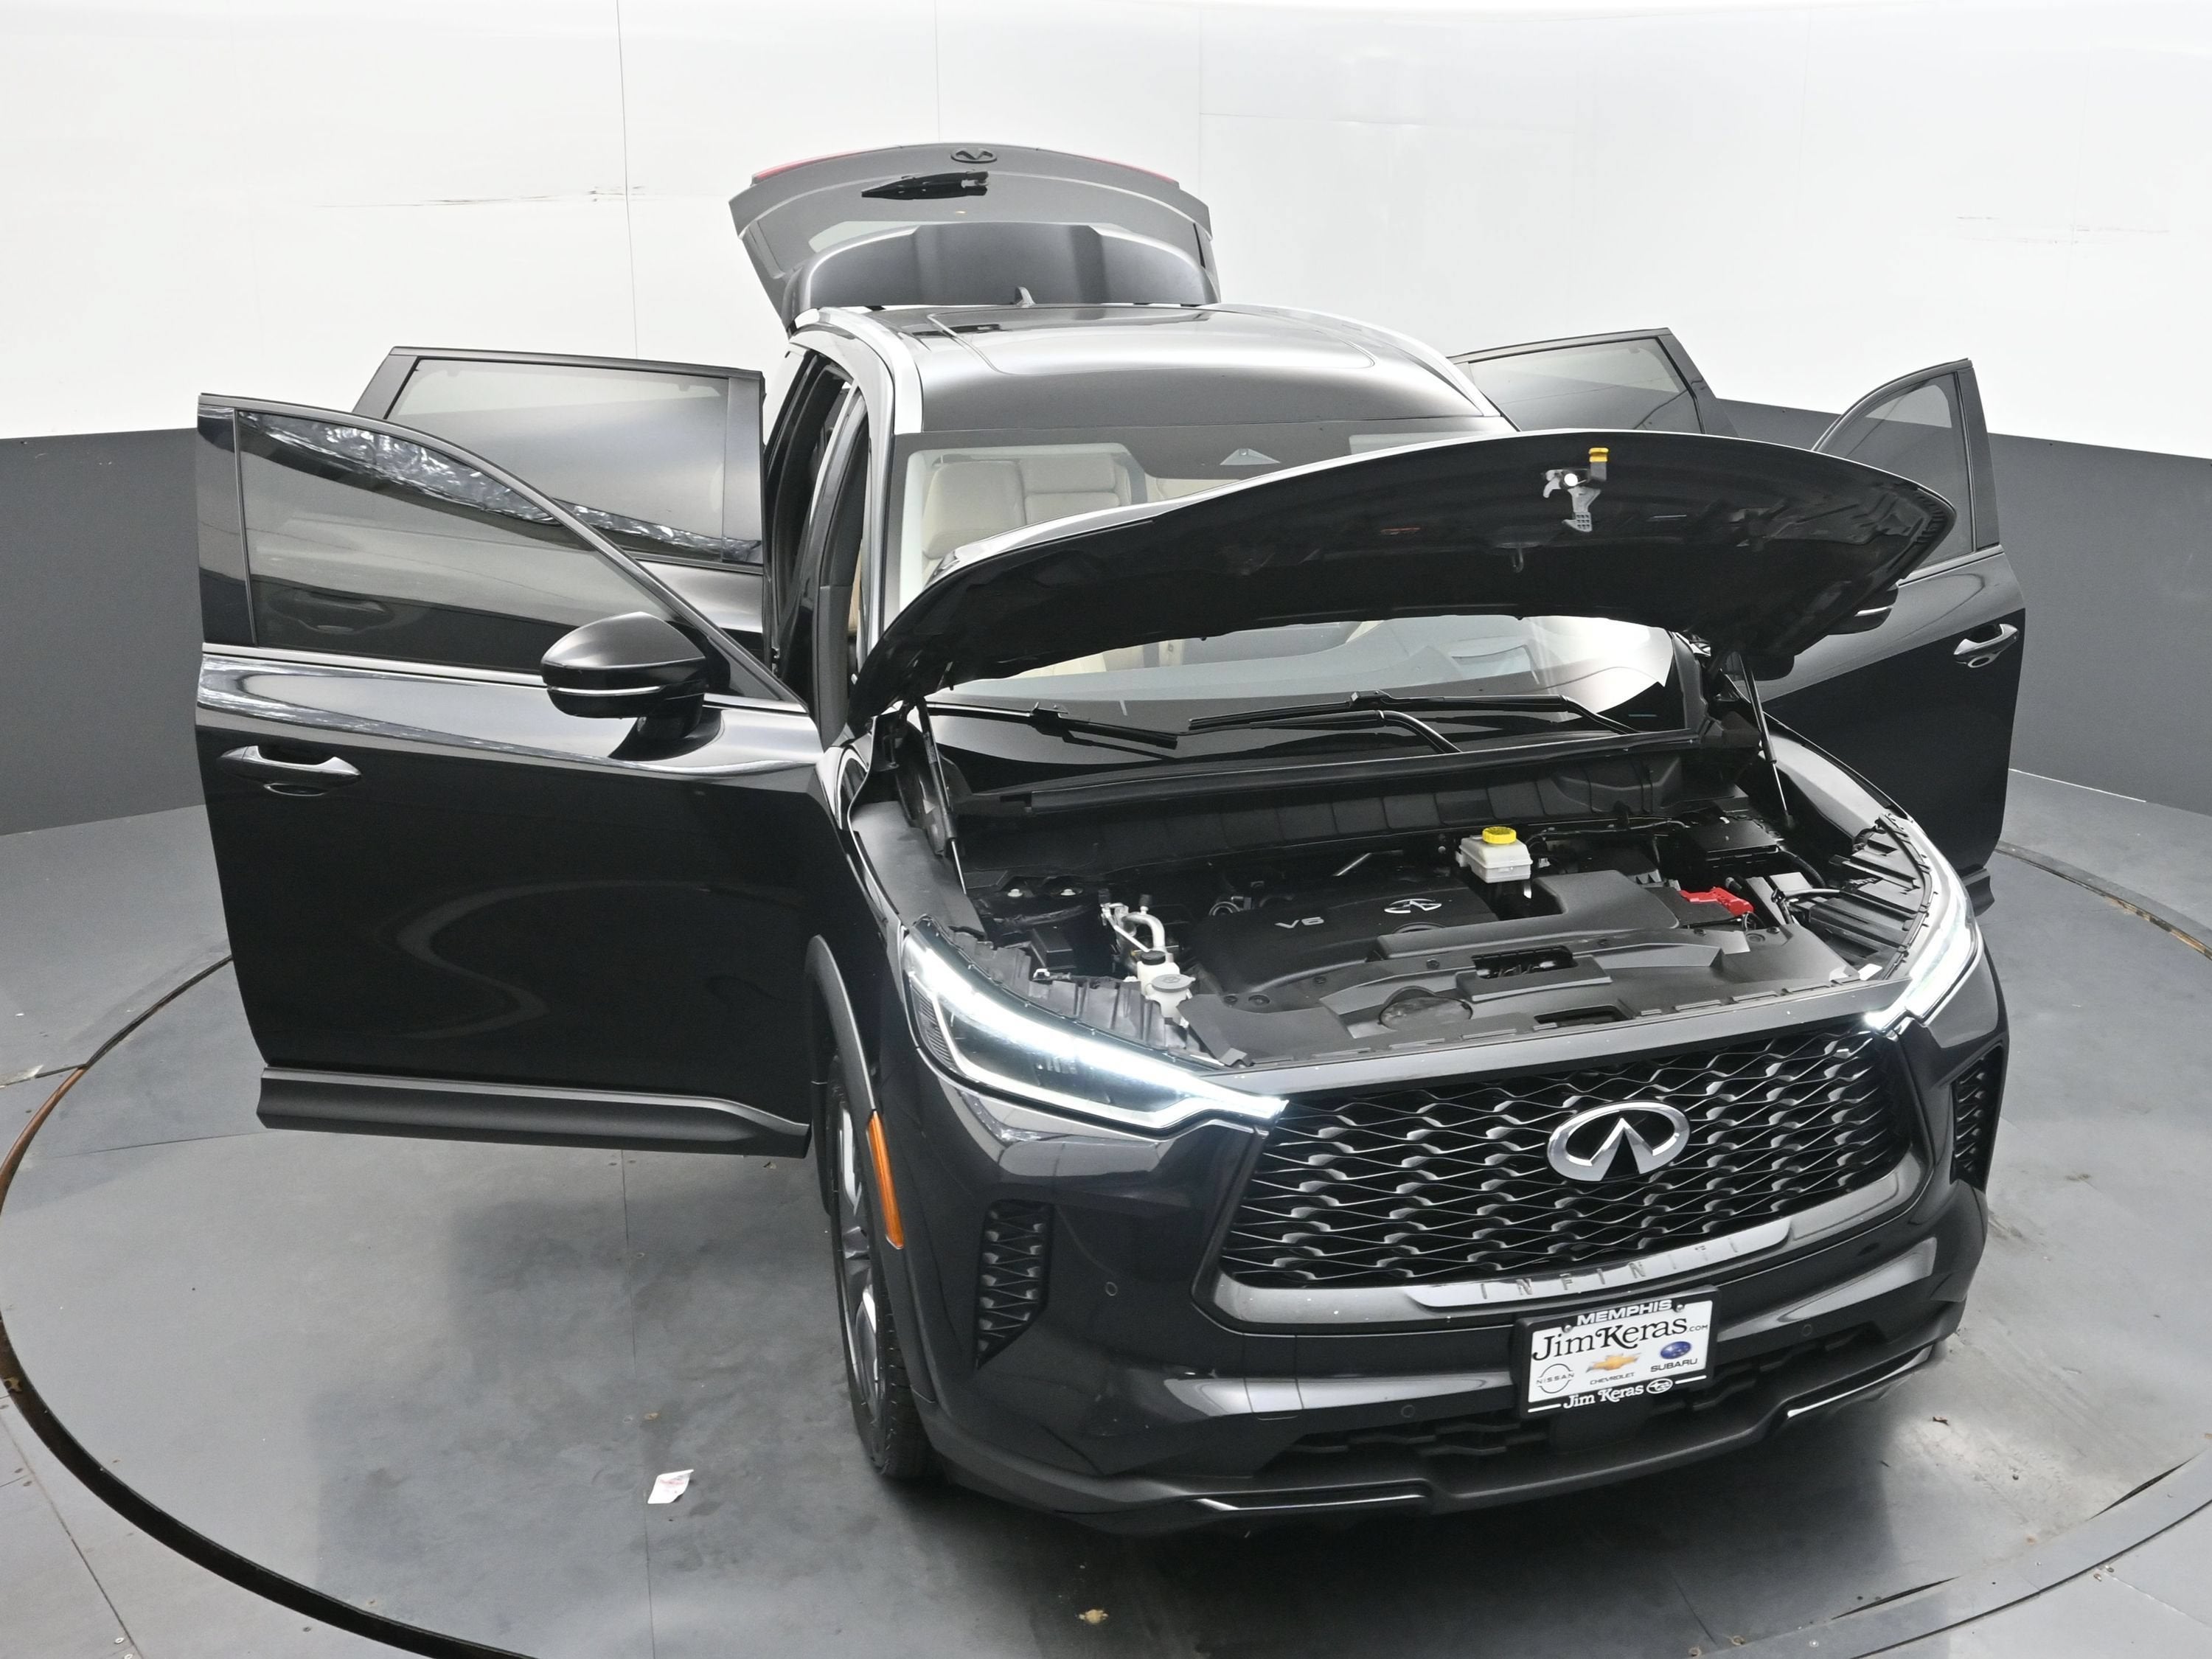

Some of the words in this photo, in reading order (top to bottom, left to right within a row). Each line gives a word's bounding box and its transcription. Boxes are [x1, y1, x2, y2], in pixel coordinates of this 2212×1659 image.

[1274, 917, 1324, 929] V6
[1481, 1237, 1738, 1300] INFINITI
[1576, 1299, 1673, 1326] MEMPHIS
[1650, 1357, 1698, 1373] SUBARU
[1536, 1372, 1575, 1385] NISSAN
[1590, 1372, 1635, 1385] CHEVROLET
[1563, 1395, 1596, 1409] Jim
[1597, 1385, 1644, 1402] Keras
